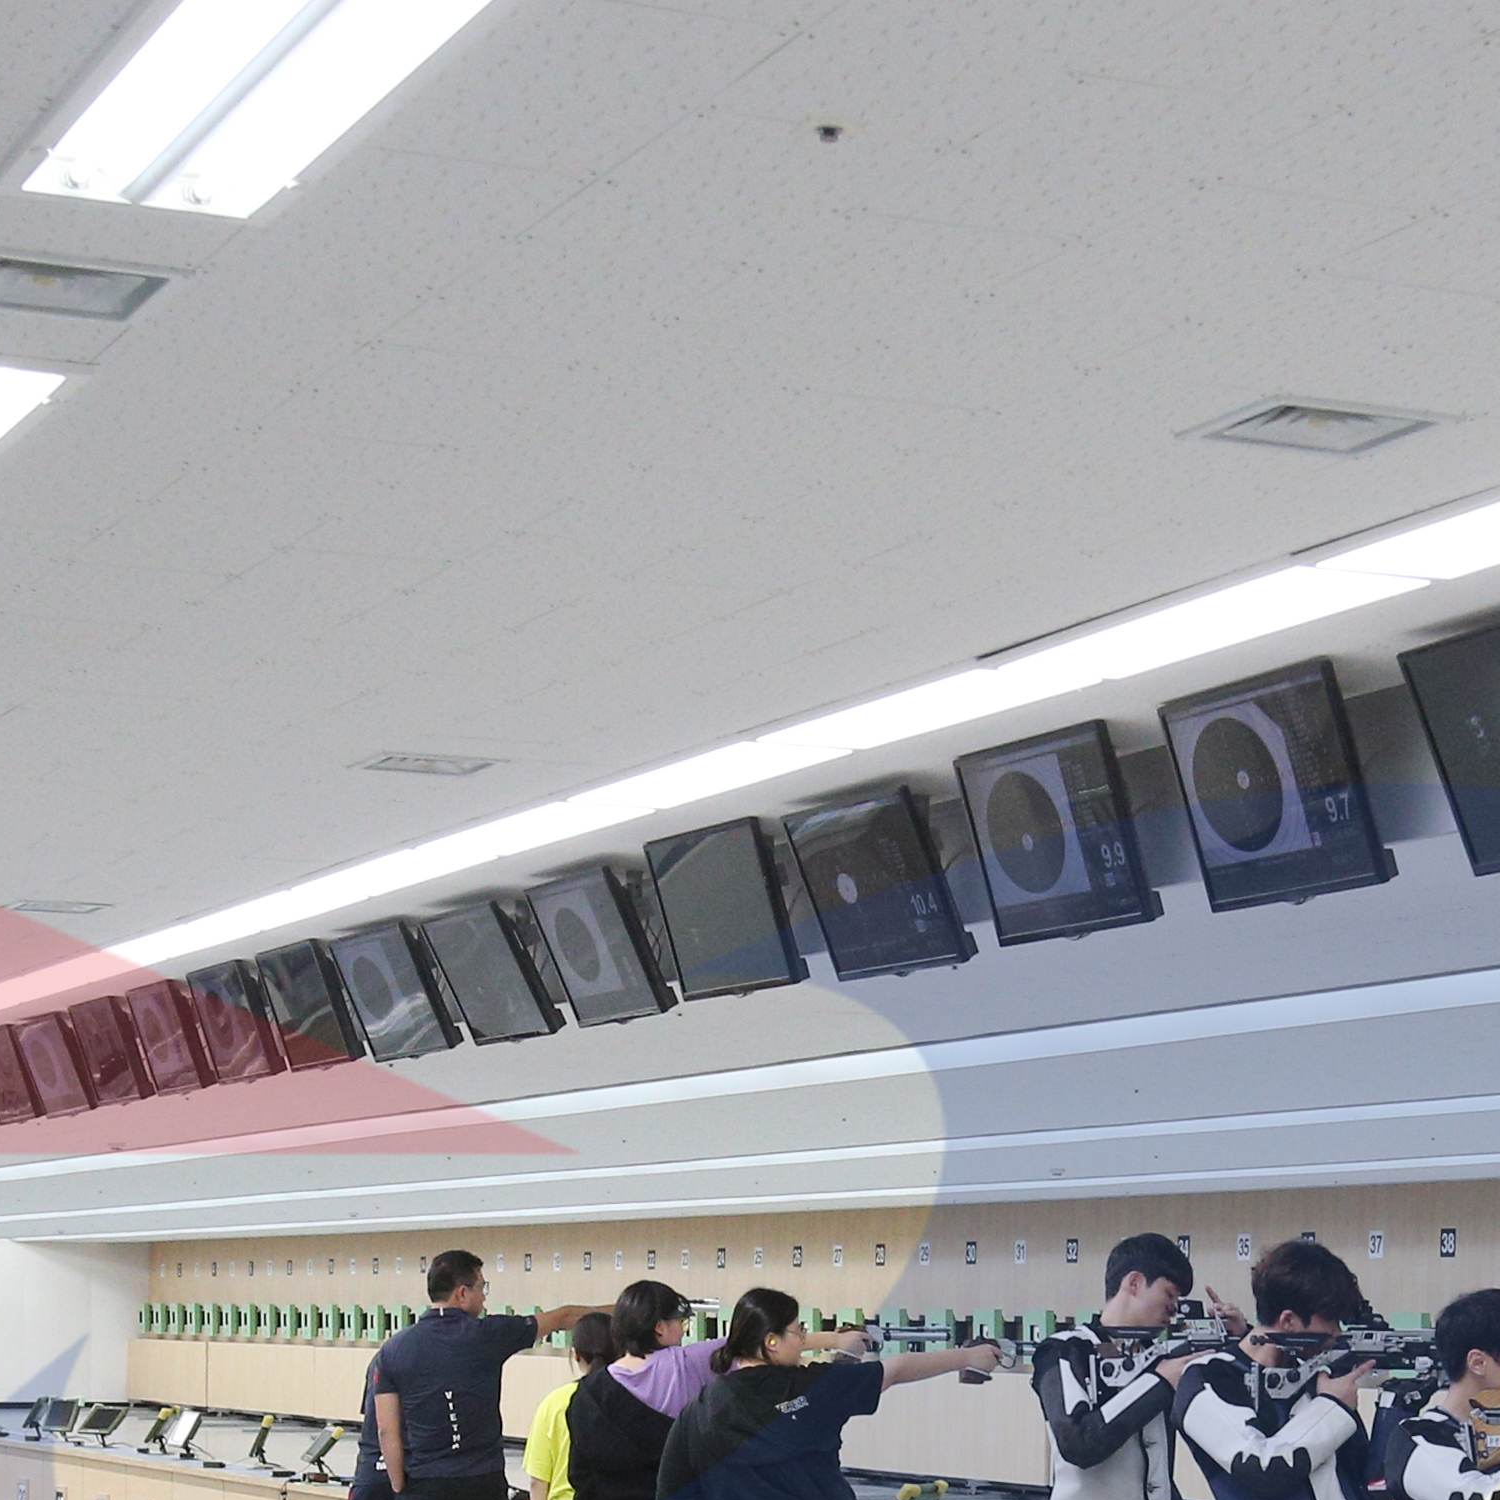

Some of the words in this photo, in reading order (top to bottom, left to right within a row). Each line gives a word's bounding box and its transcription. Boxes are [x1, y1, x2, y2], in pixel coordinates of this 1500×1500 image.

[1325, 792, 1350, 822] 9.7
[1101, 841, 1125, 868] 9.9
[911, 892, 938, 916] 10.4
[1016, 1243, 1026, 1261] 31
[1067, 1242, 1078, 1259] 32
[1238, 1238, 1250, 1256] 35
[1369, 1235, 1383, 1254] 37
[1441, 1232, 1455, 1253] 38
[967, 1244, 976, 1262] 30
